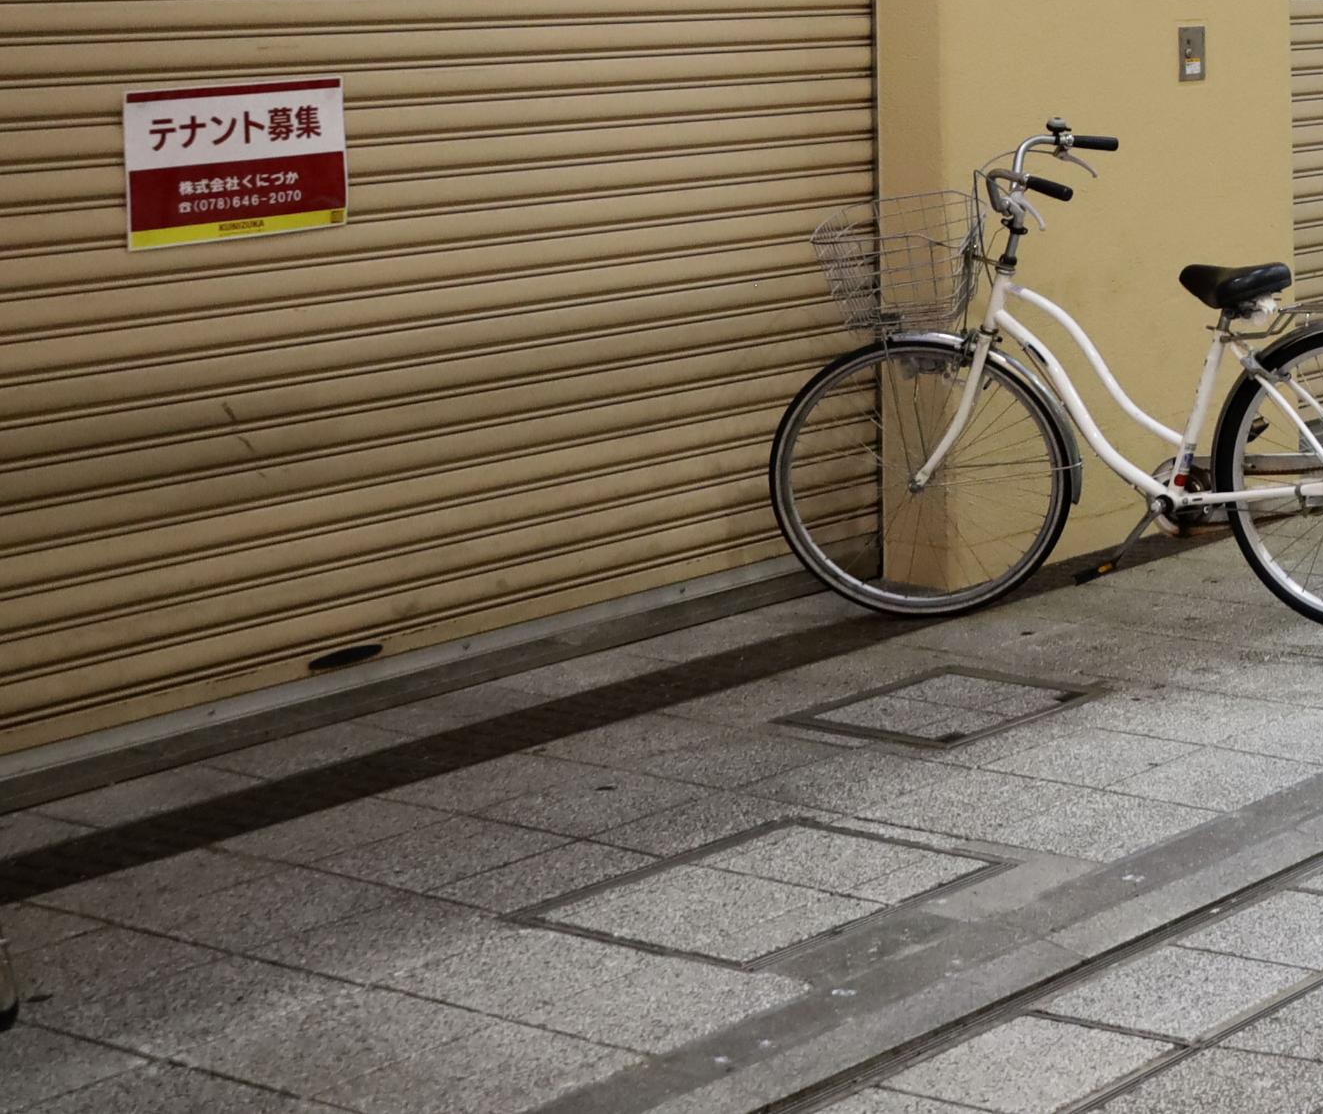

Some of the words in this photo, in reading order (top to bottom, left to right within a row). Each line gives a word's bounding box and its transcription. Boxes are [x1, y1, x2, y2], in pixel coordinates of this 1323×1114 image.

[149, 104, 322, 151] テナント募集
[178, 171, 299, 196] 株式会社くにづか
